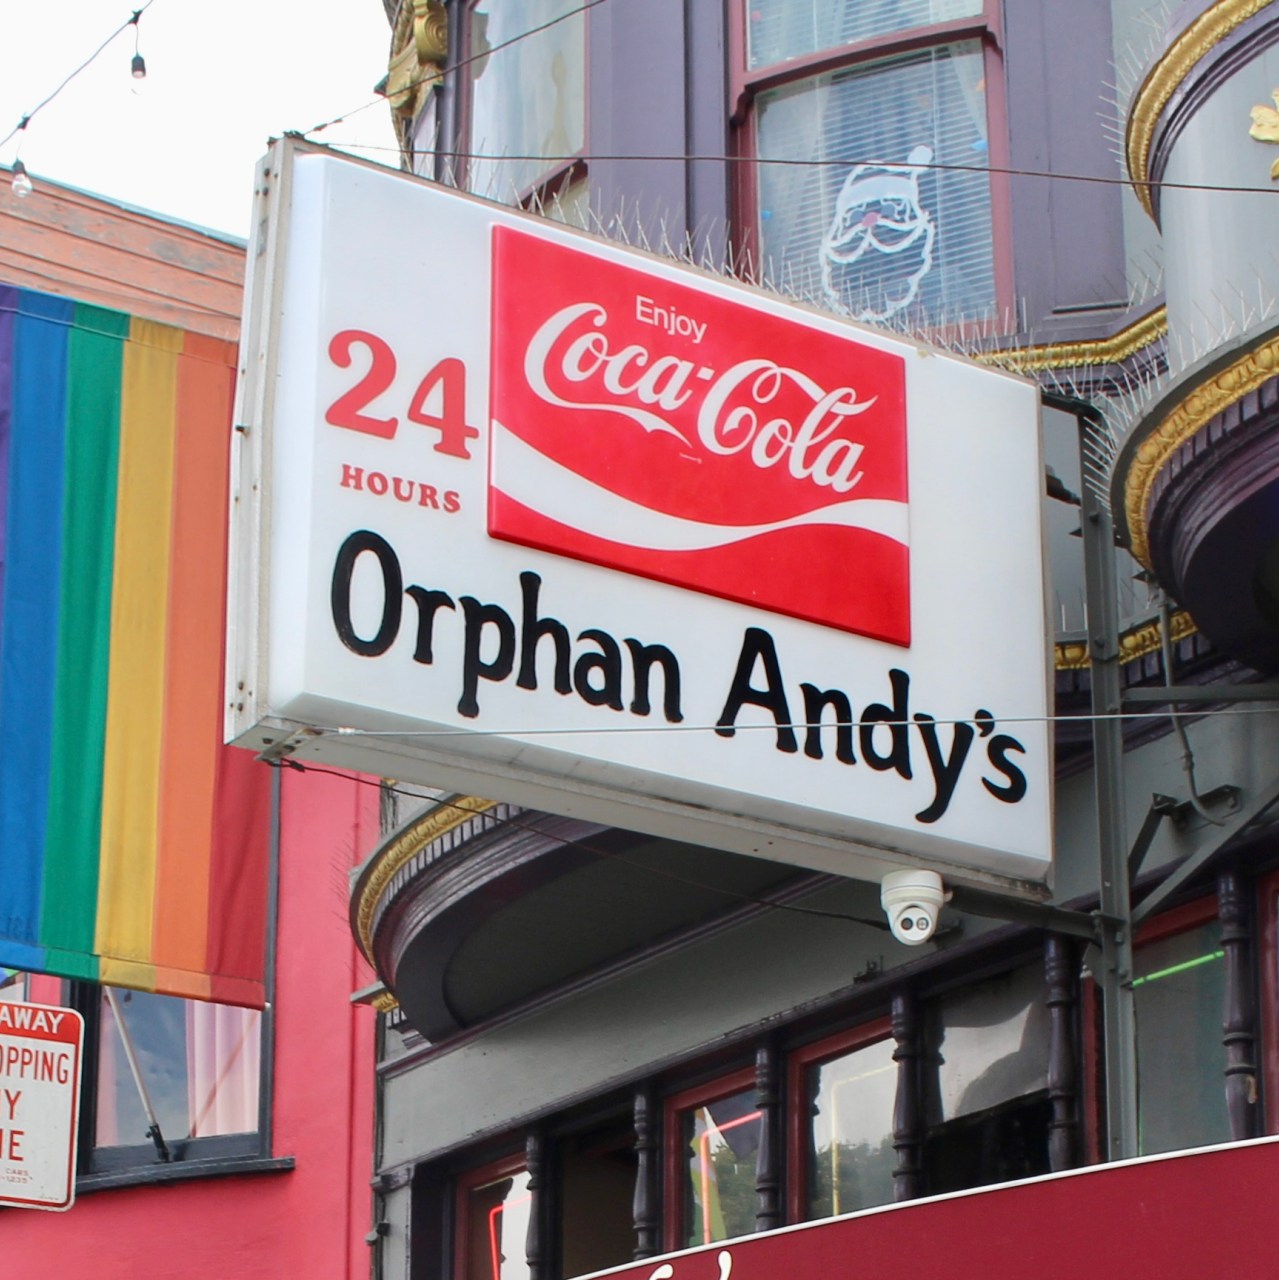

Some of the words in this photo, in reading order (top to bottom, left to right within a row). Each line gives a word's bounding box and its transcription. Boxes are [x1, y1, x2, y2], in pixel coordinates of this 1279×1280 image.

[636, 294, 707, 345] Enjoy
[324, 329, 481, 461] 24
[524, 301, 880, 494] Coca-Cola
[339, 463, 462, 514] HOURS
[331, 529, 683, 719] Orphan
[714, 627, 1028, 824] Andy's
